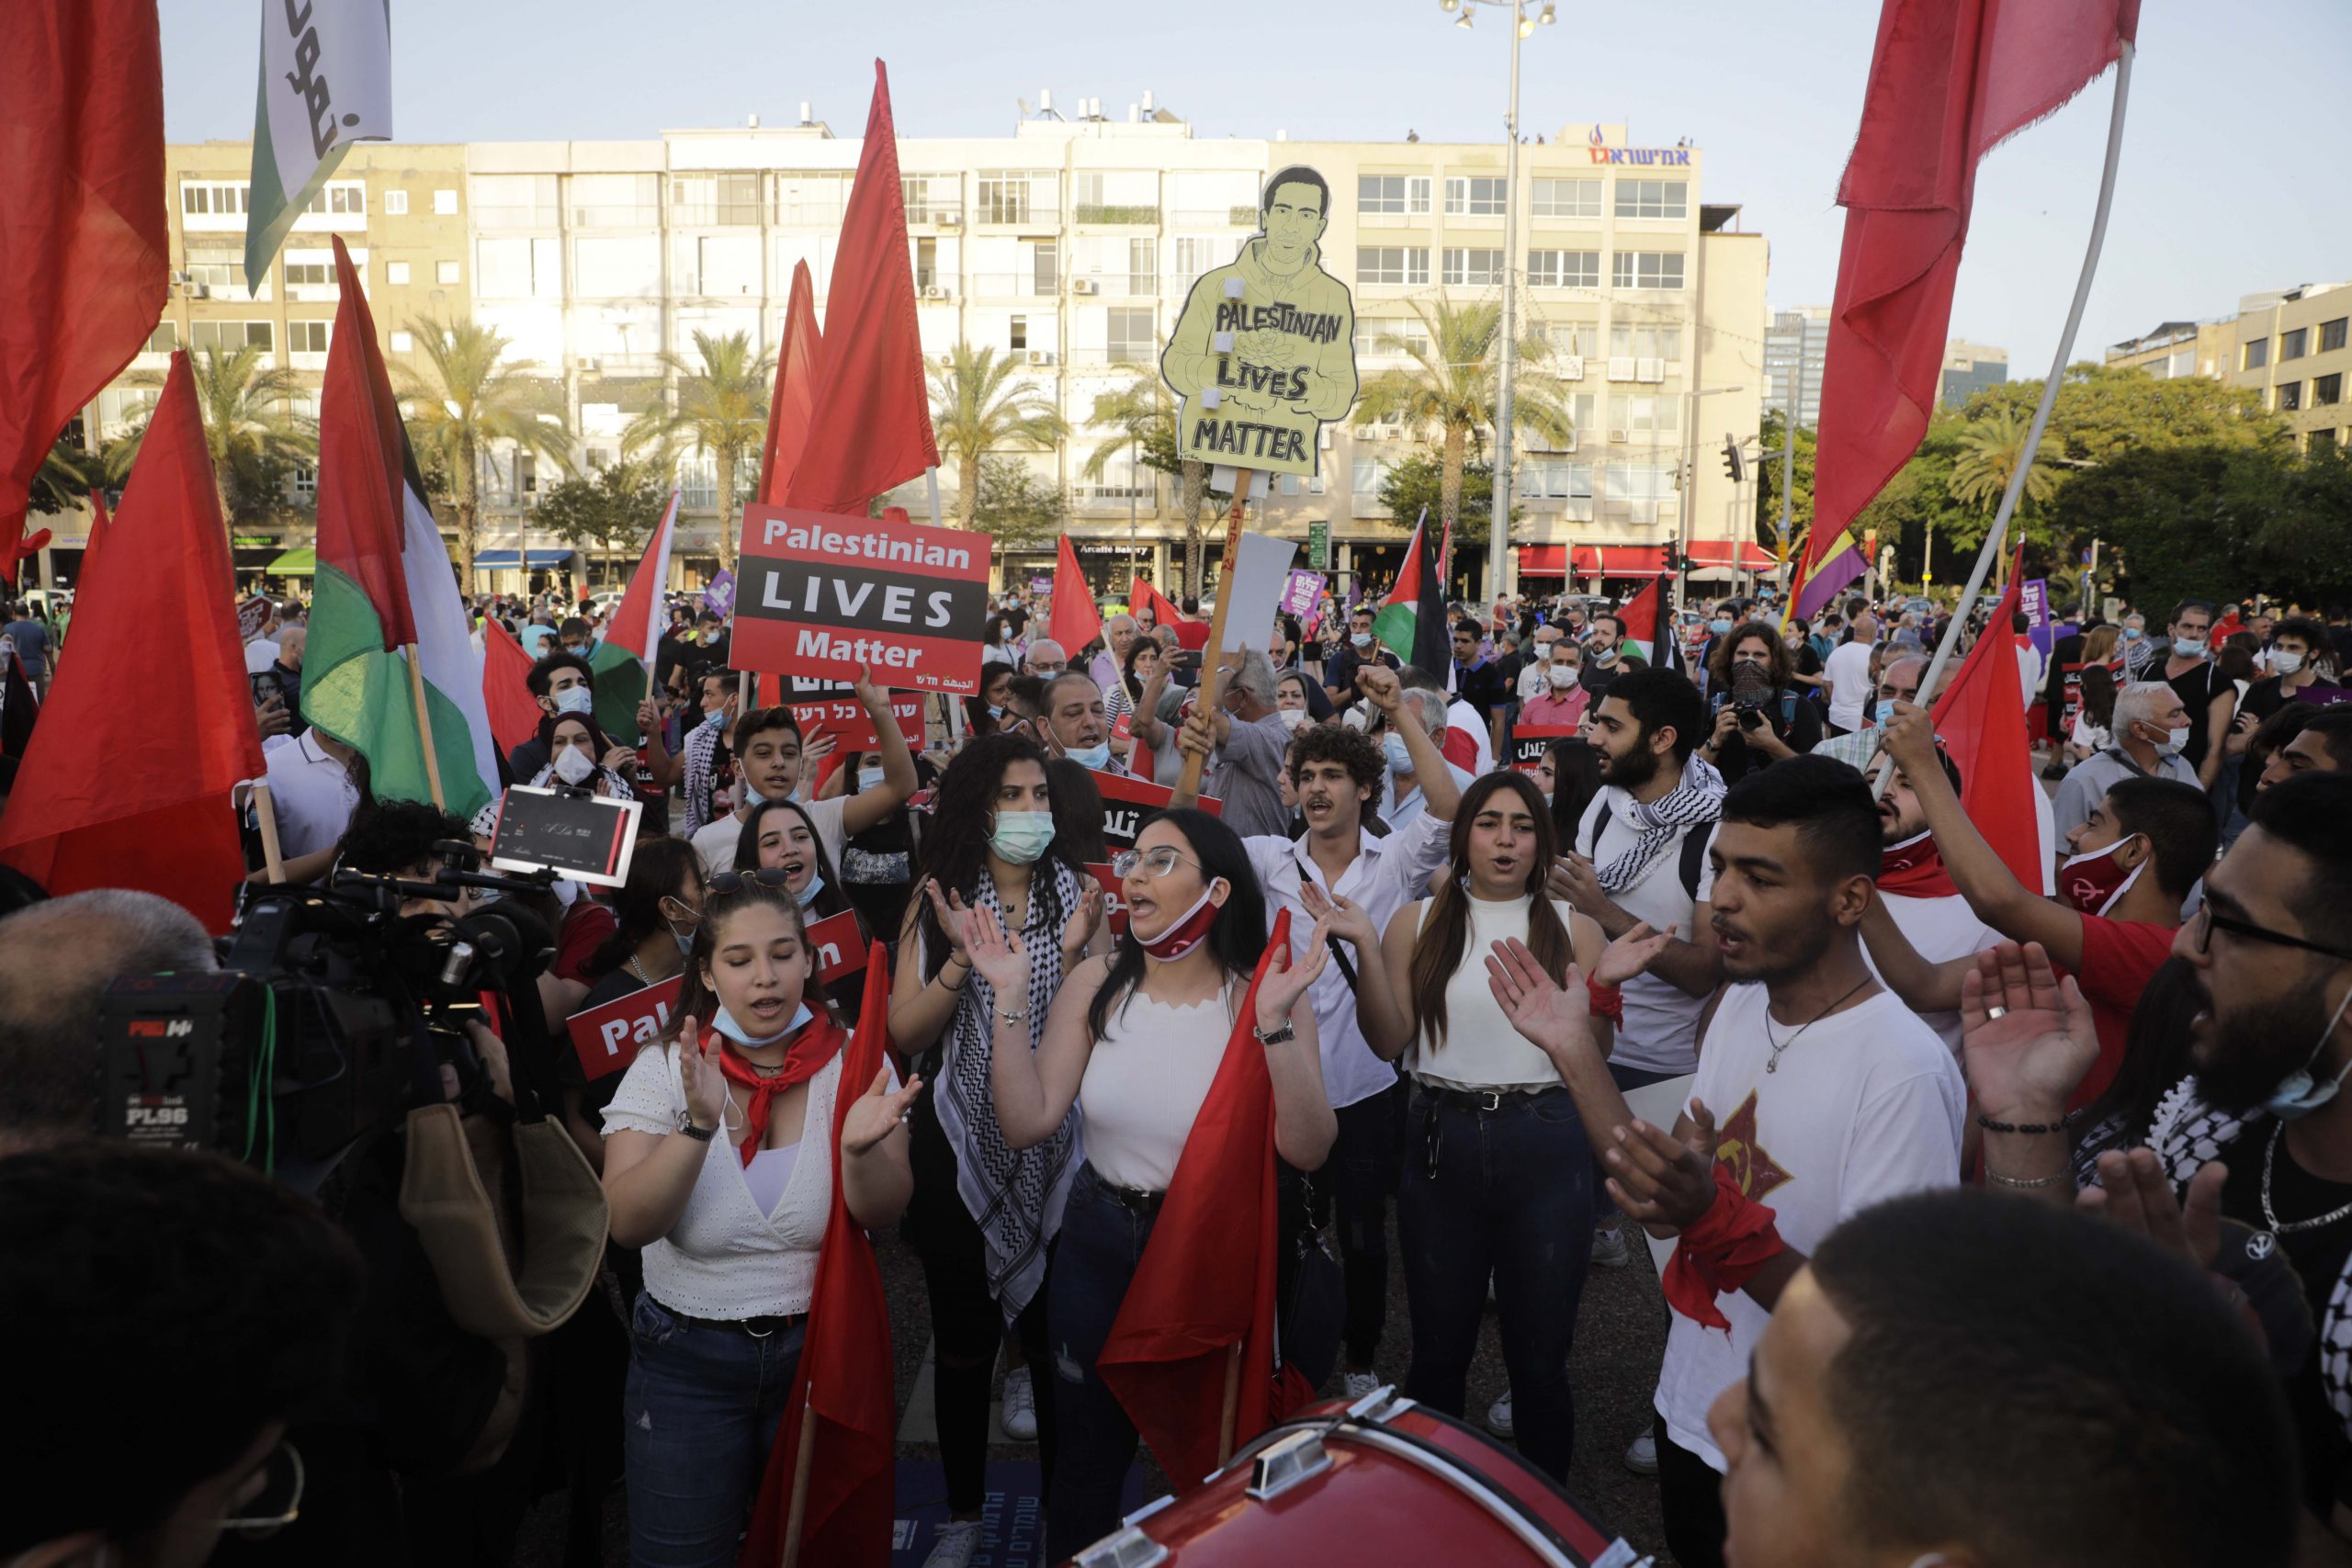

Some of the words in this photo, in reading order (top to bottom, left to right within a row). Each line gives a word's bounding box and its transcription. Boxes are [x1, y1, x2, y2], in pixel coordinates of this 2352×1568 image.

[1588, 147, 1690, 165] אמישראגז
[1215, 301, 1344, 344] PALESTINIAN
[1216, 357, 1311, 399] LIVES
[1191, 418, 1309, 462] MATTER
[763, 518, 971, 570] Palestinian
[762, 570, 954, 628] LIVES
[795, 629, 922, 669] Matter
[831, 703, 857, 720] כל
